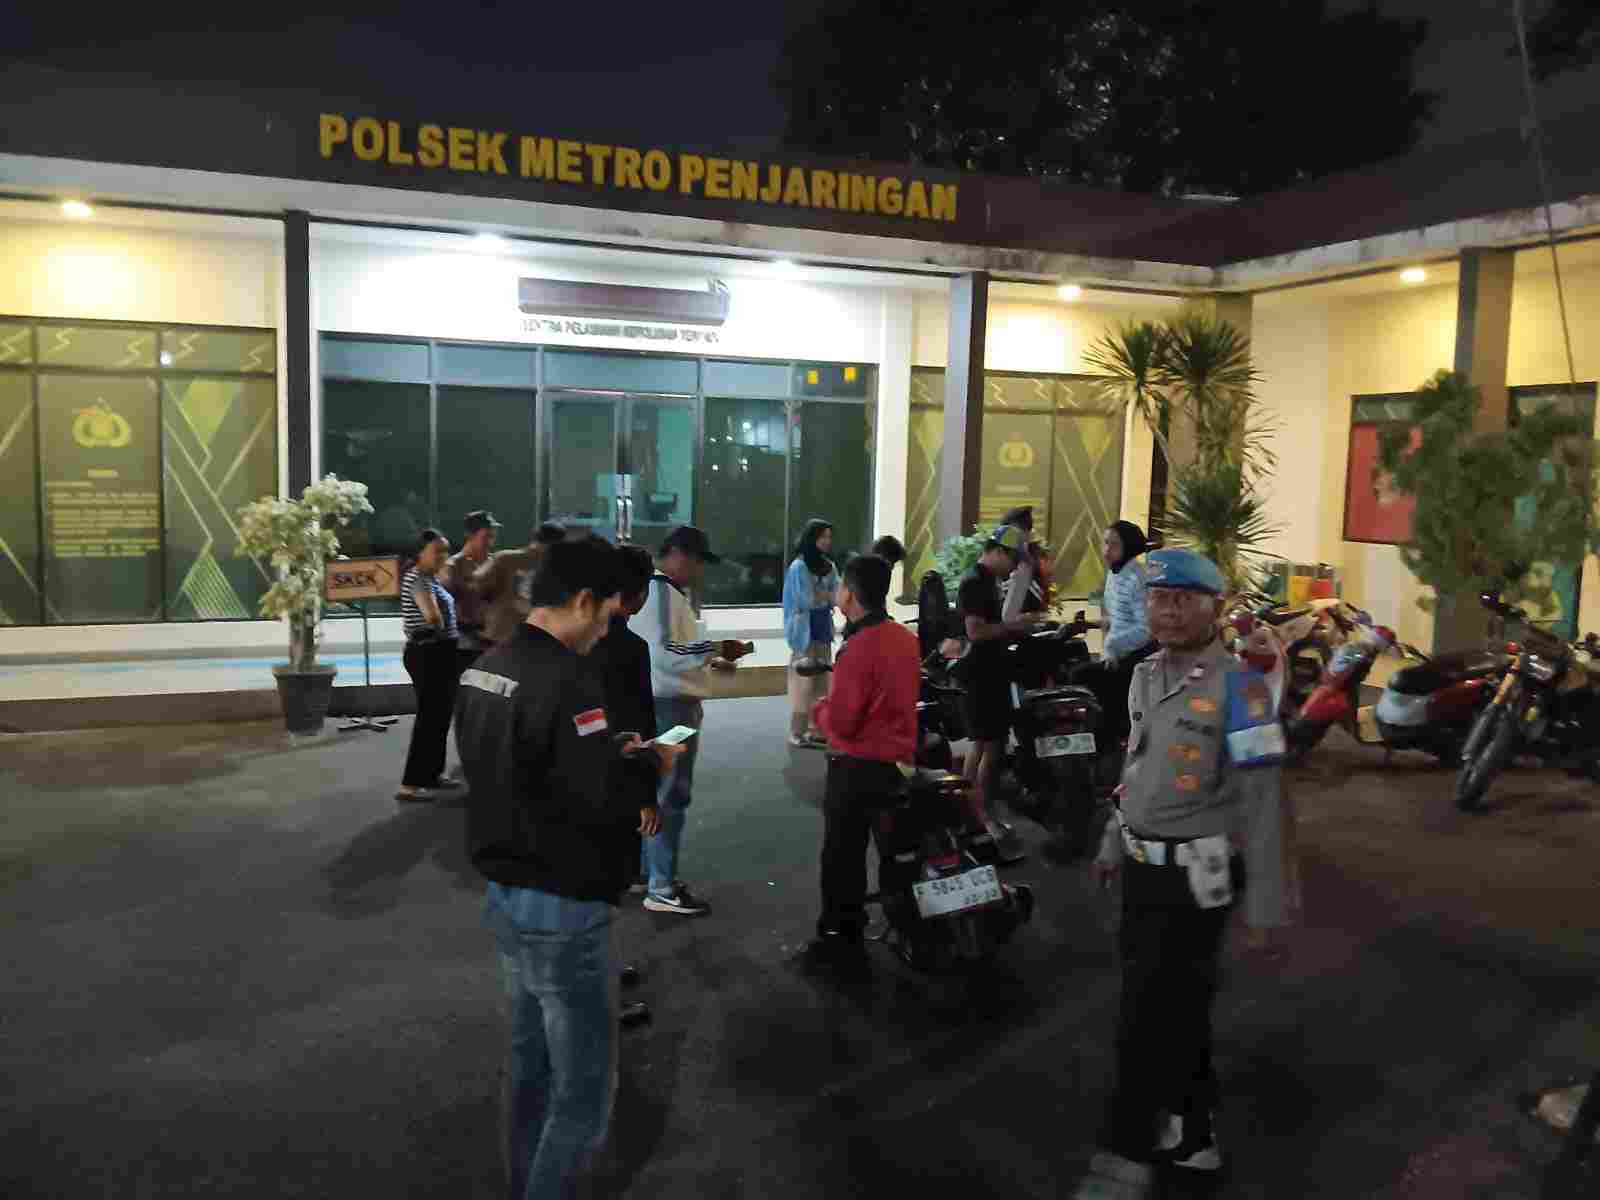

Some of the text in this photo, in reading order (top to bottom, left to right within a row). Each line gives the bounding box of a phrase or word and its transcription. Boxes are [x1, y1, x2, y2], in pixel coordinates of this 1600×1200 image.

[319, 113, 957, 221] POLSEK METRO PENJARINGAN
